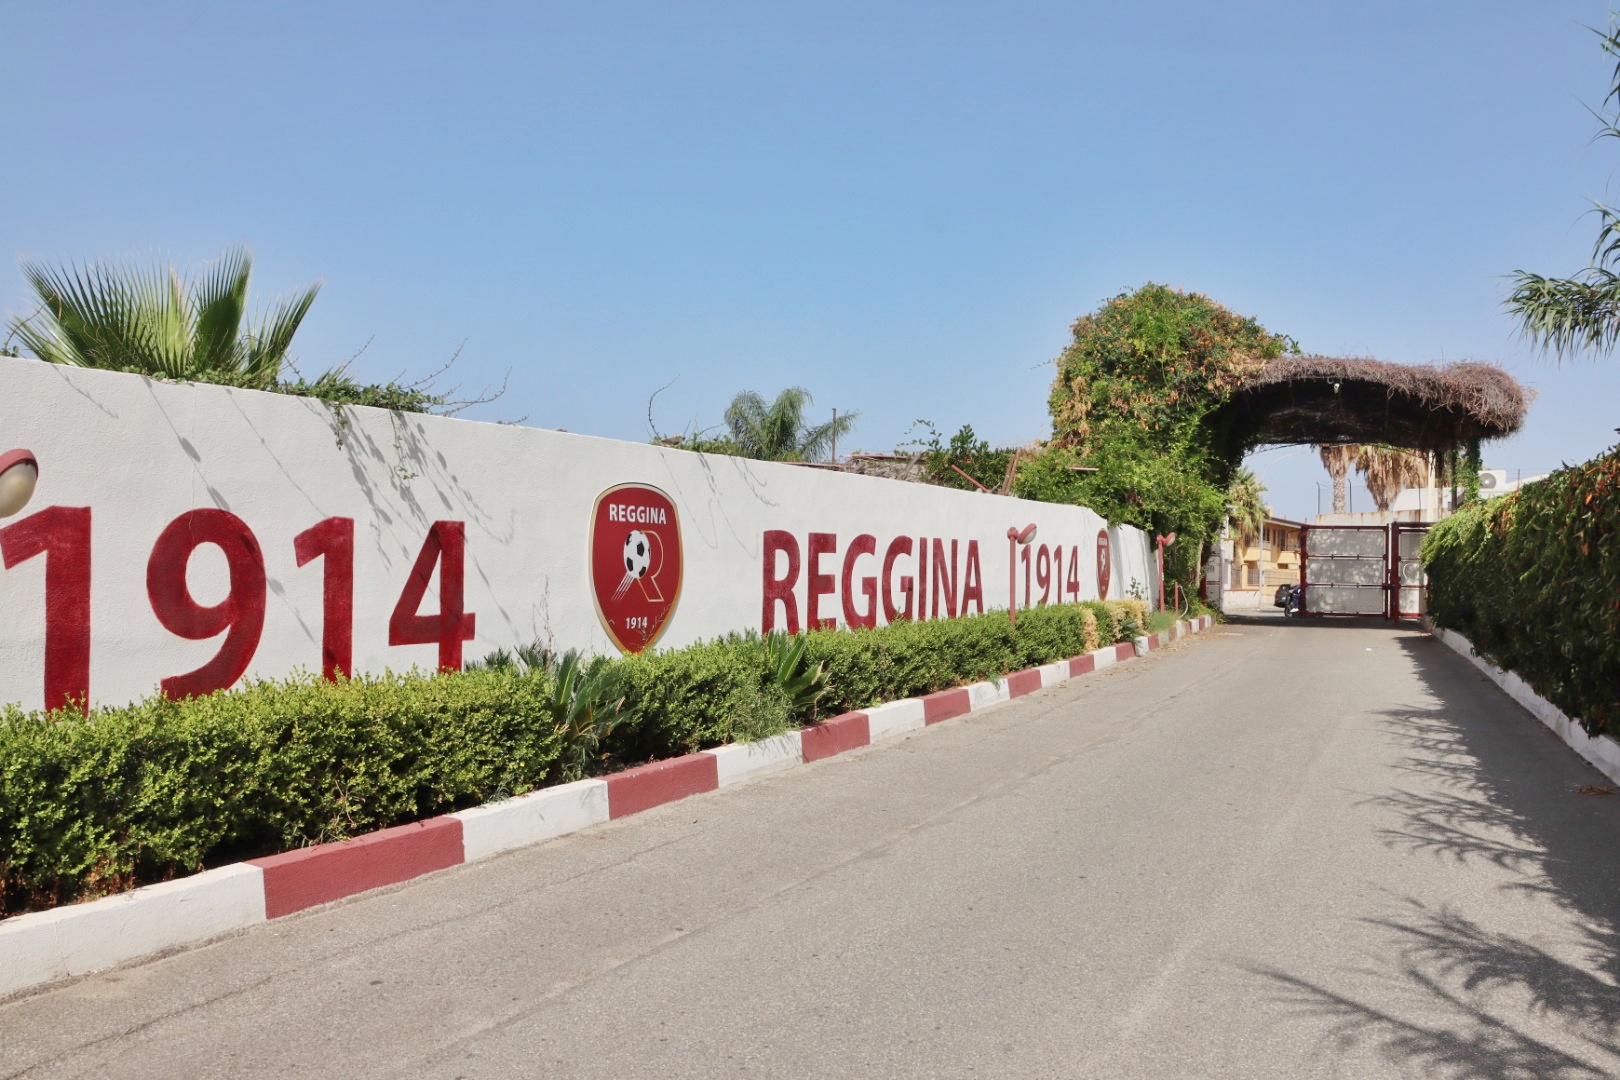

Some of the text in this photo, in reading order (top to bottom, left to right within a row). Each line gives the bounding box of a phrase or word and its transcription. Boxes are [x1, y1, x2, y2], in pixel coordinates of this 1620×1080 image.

[609, 503, 667, 524] REGGINA
[0, 505, 476, 719] 1914
[762, 529, 1080, 635] REGGINA 1914
[625, 616, 648, 630] 1914
